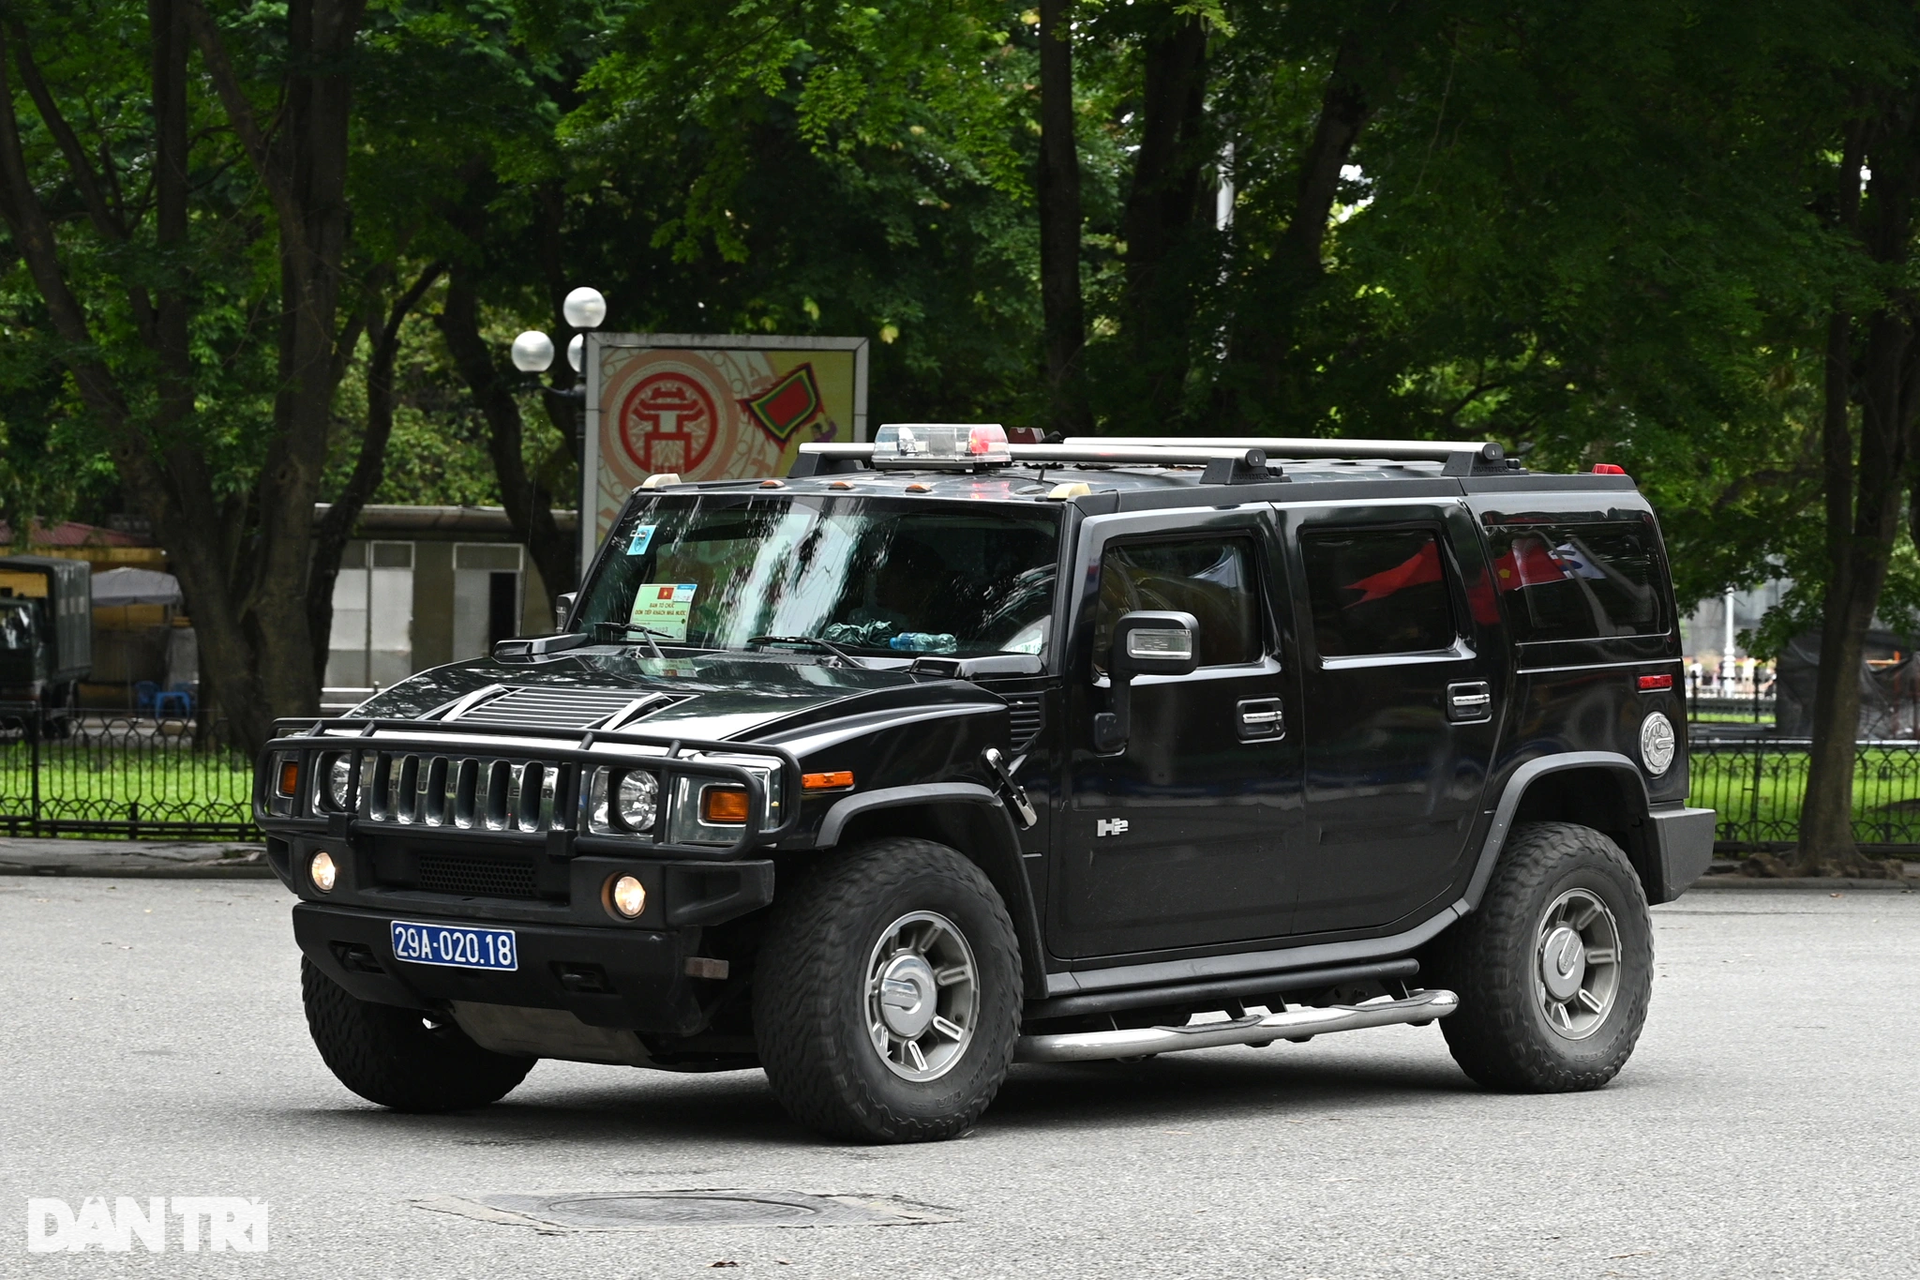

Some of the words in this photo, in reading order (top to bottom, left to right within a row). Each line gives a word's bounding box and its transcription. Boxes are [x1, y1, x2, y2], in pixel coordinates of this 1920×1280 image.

[389, 779, 554, 800] HUMMER
[1097, 817, 1129, 837] H2
[394, 926, 513, 966] 29A-020.18
